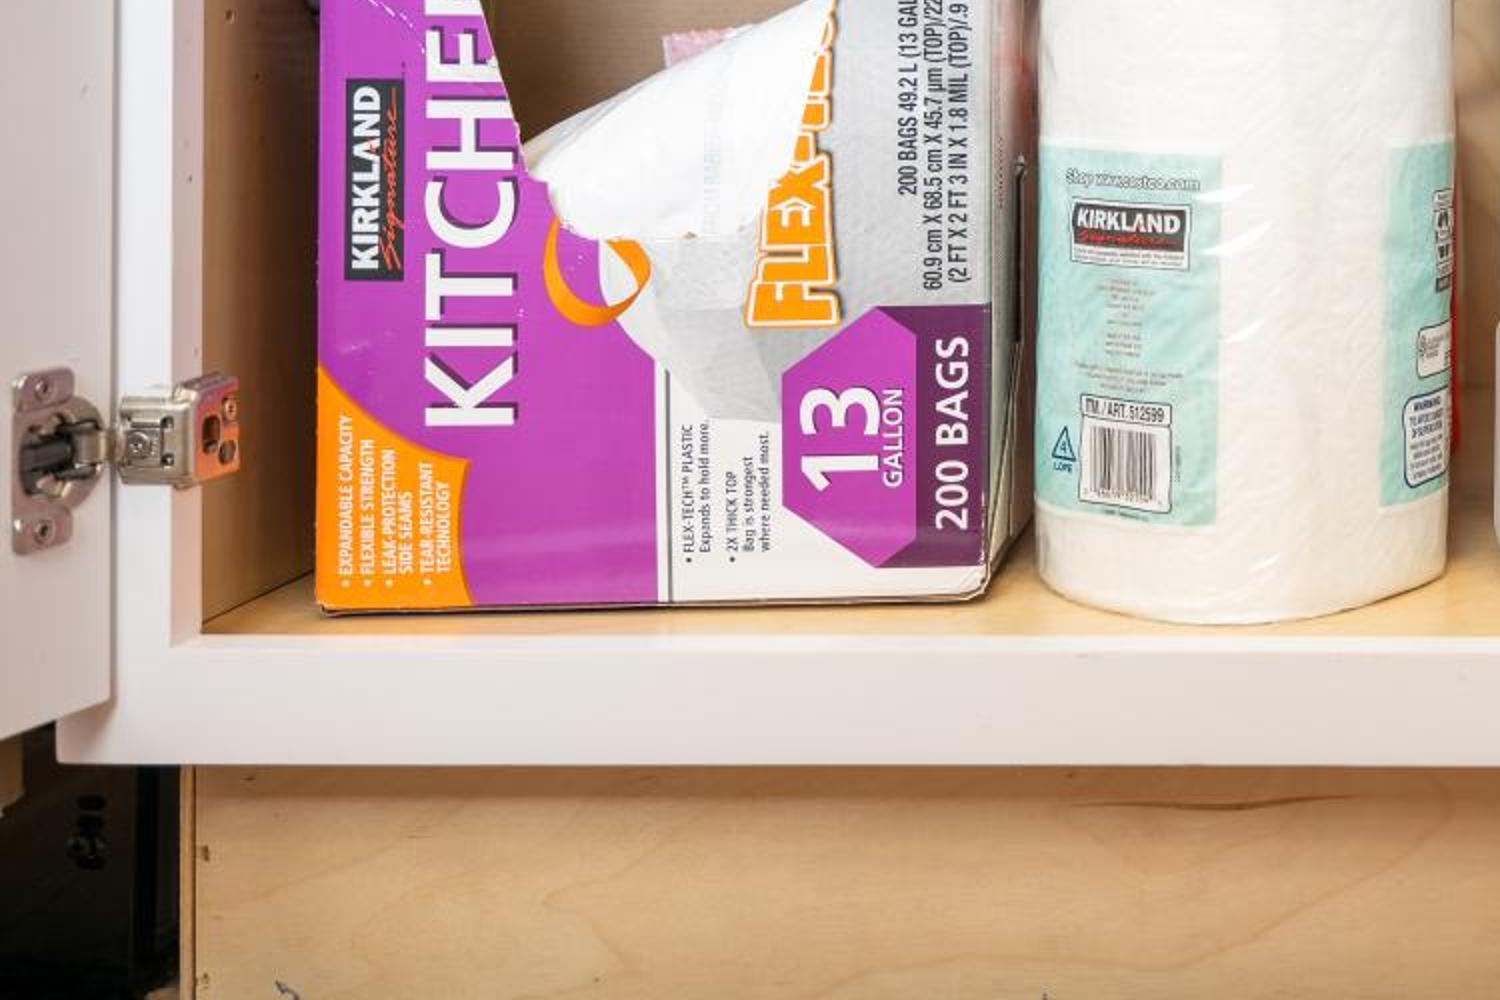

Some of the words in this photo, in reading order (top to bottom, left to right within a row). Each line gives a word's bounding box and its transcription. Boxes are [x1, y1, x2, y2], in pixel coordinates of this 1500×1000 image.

[898, 32, 920, 57] (13
[898, 63, 917, 72] L
[899, 78, 918, 111] 49.2
[948, 74, 967, 102] MIL
[923, 97, 942, 129] 45.7
[948, 108, 967, 132] 1.8
[899, 117, 918, 160] BAGS
[924, 135, 942, 145] X
[948, 138, 967, 148] X
[928, 150, 942, 172] cm
[948, 153, 967, 169] IN
[351, 85, 381, 269] KIRKLAND
[899, 165, 918, 195] 200
[948, 174, 967, 184] 3
[924, 177, 942, 210] 68.5
[948, 191, 967, 208] FT
[924, 214, 942, 224] X
[948, 213, 967, 223] 2
[1077, 207, 1181, 235] KIRKLAND
[929, 229, 943, 252] cm
[948, 228, 967, 239] X
[948, 245, 967, 262] FT
[924, 257, 943, 290] 60.9
[949, 267, 970, 282] (2
[935, 336, 969, 446] BAGS
[339, 415, 352, 480] CAPACITY
[681, 424, 692, 472] PLASTIC
[800, 387, 880, 491] 13
[882, 388, 904, 488] GALLON
[360, 440, 374, 510] STRENGTH
[699, 458, 710, 485] hold
[726, 471, 737, 493] TOP
[742, 457, 756, 512] strongest
[700, 488, 710, 500] to
[758, 467, 769, 511] needed
[935, 460, 969, 530] 200
[399, 492, 412, 538] SEAMS
[436, 481, 451, 572] TECHNOLOGY
[699, 504, 712, 553] Expands
[726, 498, 737, 532] THICK
[339, 486, 352, 575] EXPANDABLE
[360, 515, 375, 575] FLEXIBLE
[726, 537, 737, 552] 2X
[743, 530, 755, 552] Bag
[759, 515, 771, 551] where
[399, 543, 412, 573] SIDE
